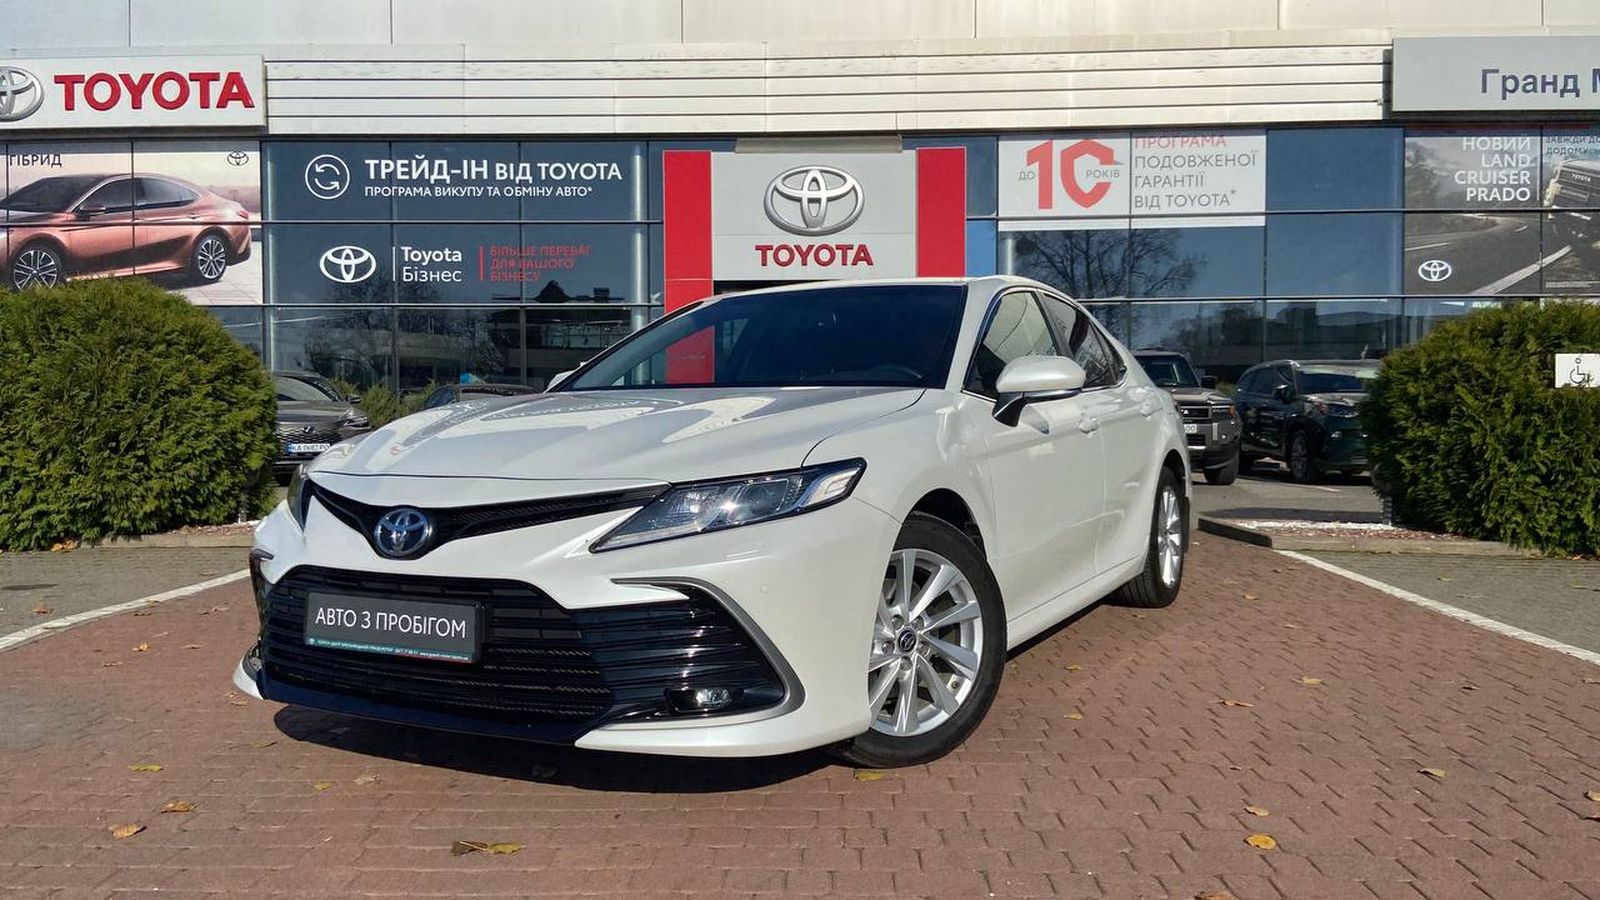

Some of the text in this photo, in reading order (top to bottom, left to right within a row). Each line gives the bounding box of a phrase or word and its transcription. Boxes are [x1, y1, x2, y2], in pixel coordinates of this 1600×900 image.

[54, 71, 255, 111] TOYOTA
[1481, 69, 1580, 100] Гранд
[1135, 136, 1227, 149] ПРОГРАМА
[1463, 135, 1530, 150] НОВИЙ
[9, 154, 62, 168] ГІБРИД
[1135, 150, 1258, 170] ПОДОВЖЕНОЇ
[1481, 153, 1530, 168] LAND
[364, 154, 622, 184] ТРЕЙД-ІН ВІД TOYOTA
[1018, 171, 1036, 181] ДО
[1086, 169, 1120, 179] РОКІВ
[1135, 171, 1204, 188] ГАРАНТІЇ
[1454, 170, 1531, 185] CRUISER
[365, 187, 432, 197] ПРОГРАМА
[435, 187, 484, 197] ВИКУПУ
[487, 187, 501, 197] ТА
[504, 187, 552, 197] ОБМІНУ
[1466, 187, 1531, 201] PRADO
[1135, 195, 1161, 209] ВІД
[401, 246, 462, 266] Toyota
[755, 244, 874, 267] TOYOTA
[402, 267, 462, 282] Бізнес
[315, 607, 357, 627] АВТО
[376, 612, 466, 638] ПРОБІГОМ
